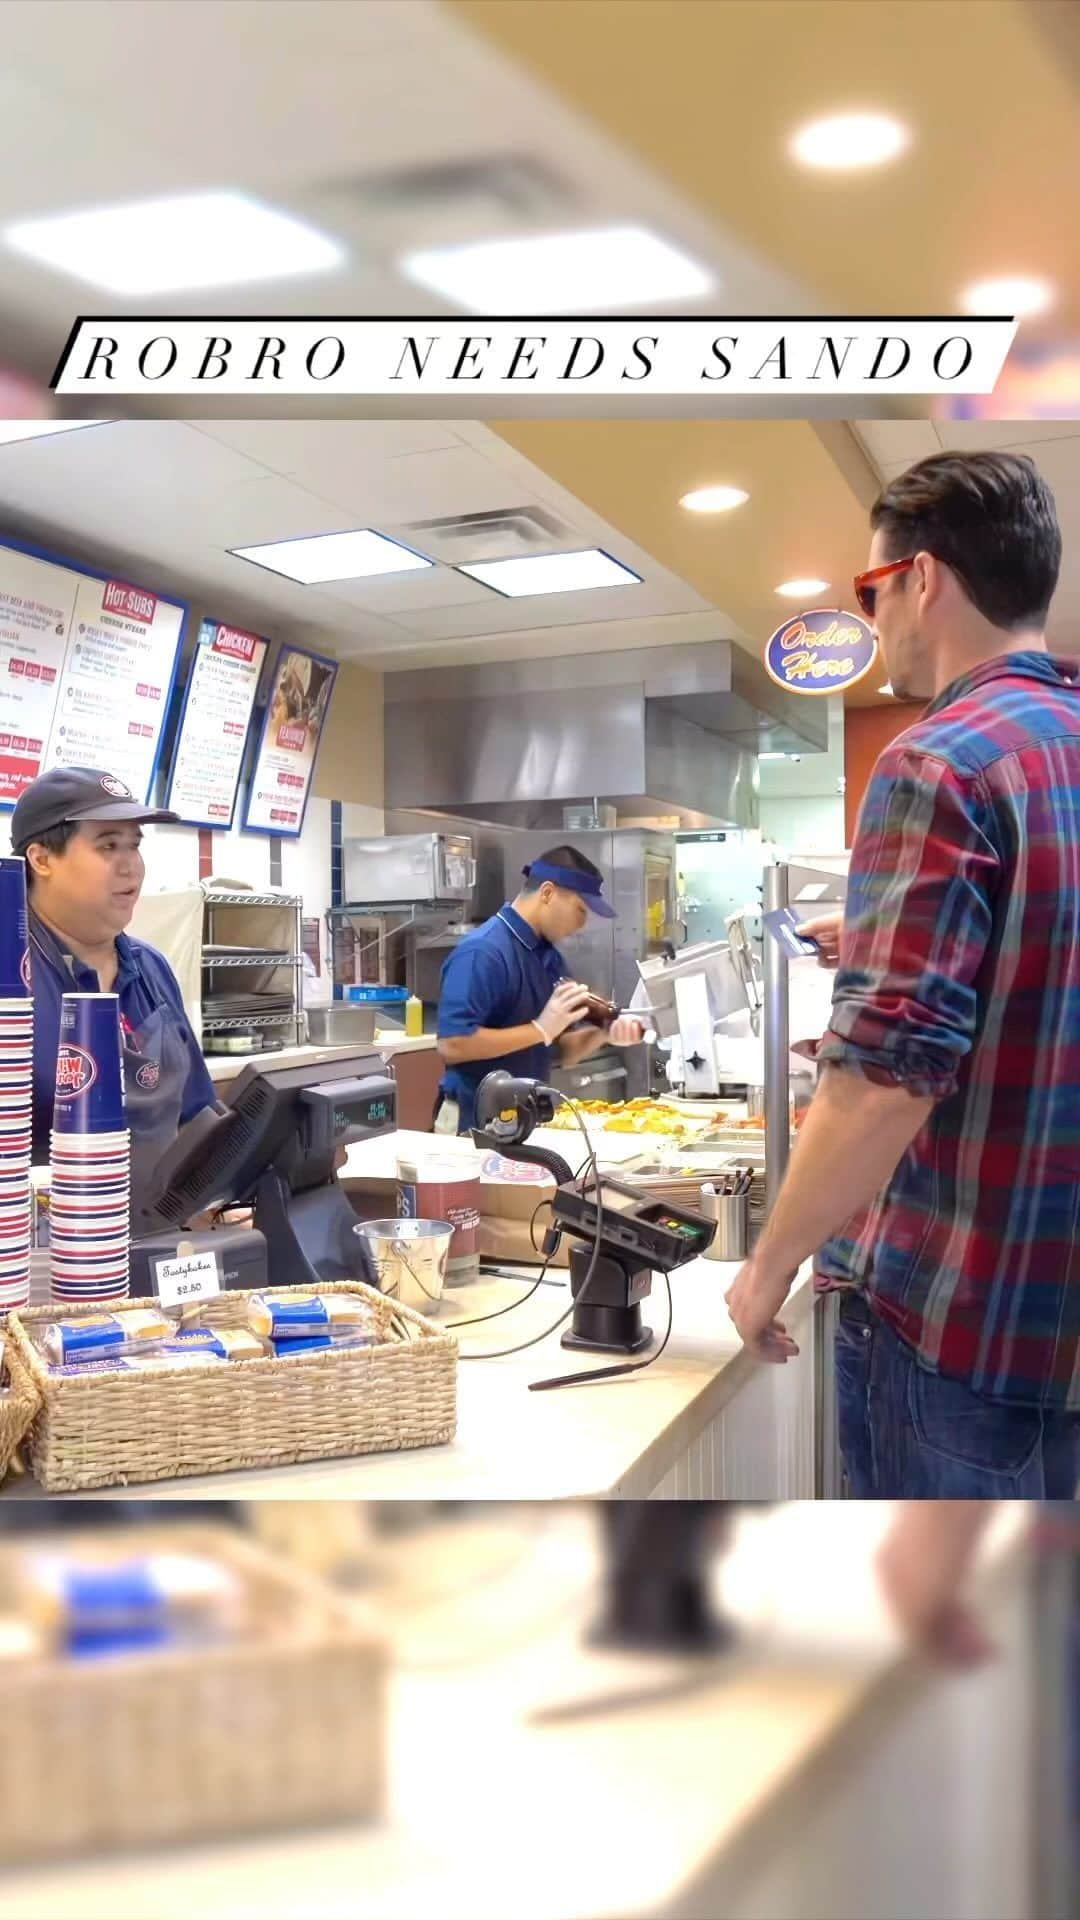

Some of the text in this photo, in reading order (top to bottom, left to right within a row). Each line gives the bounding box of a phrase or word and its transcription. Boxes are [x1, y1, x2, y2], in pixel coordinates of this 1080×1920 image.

[105, 583, 127, 607] HOT
[127, 591, 154, 618] SUBS
[215, 625, 255, 656] CHICKEN
[781, 621, 862, 649] Order
[782, 651, 854, 680] Here
[177, 1282, 202, 1296] $2.50
